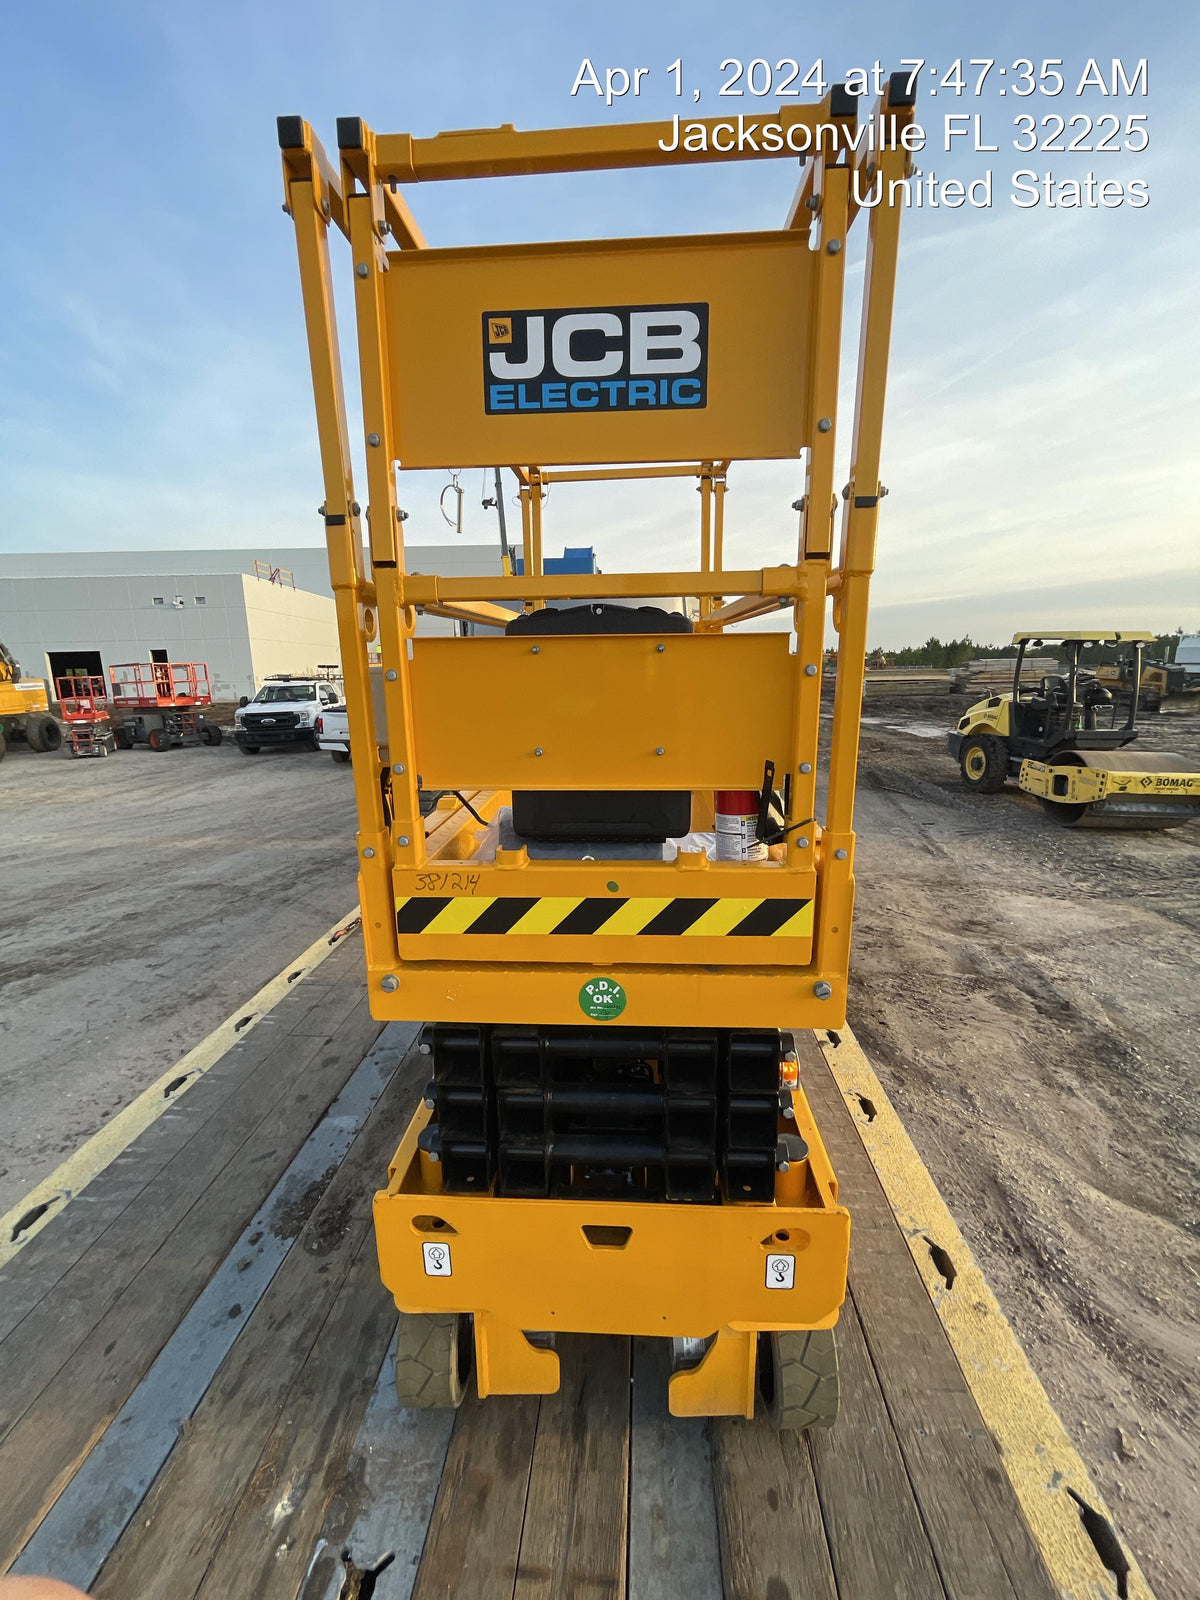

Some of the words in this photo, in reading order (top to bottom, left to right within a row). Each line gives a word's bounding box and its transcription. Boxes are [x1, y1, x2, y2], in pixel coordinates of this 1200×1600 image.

[494, 324, 510, 337] JCB
[489, 310, 702, 380] JCB
[489, 378, 702, 410] ELECTRIC
[1155, 778, 1193, 788] BOMAG
[585, 981, 620, 998] P.D.I.
[592, 994, 613, 1004] OK
